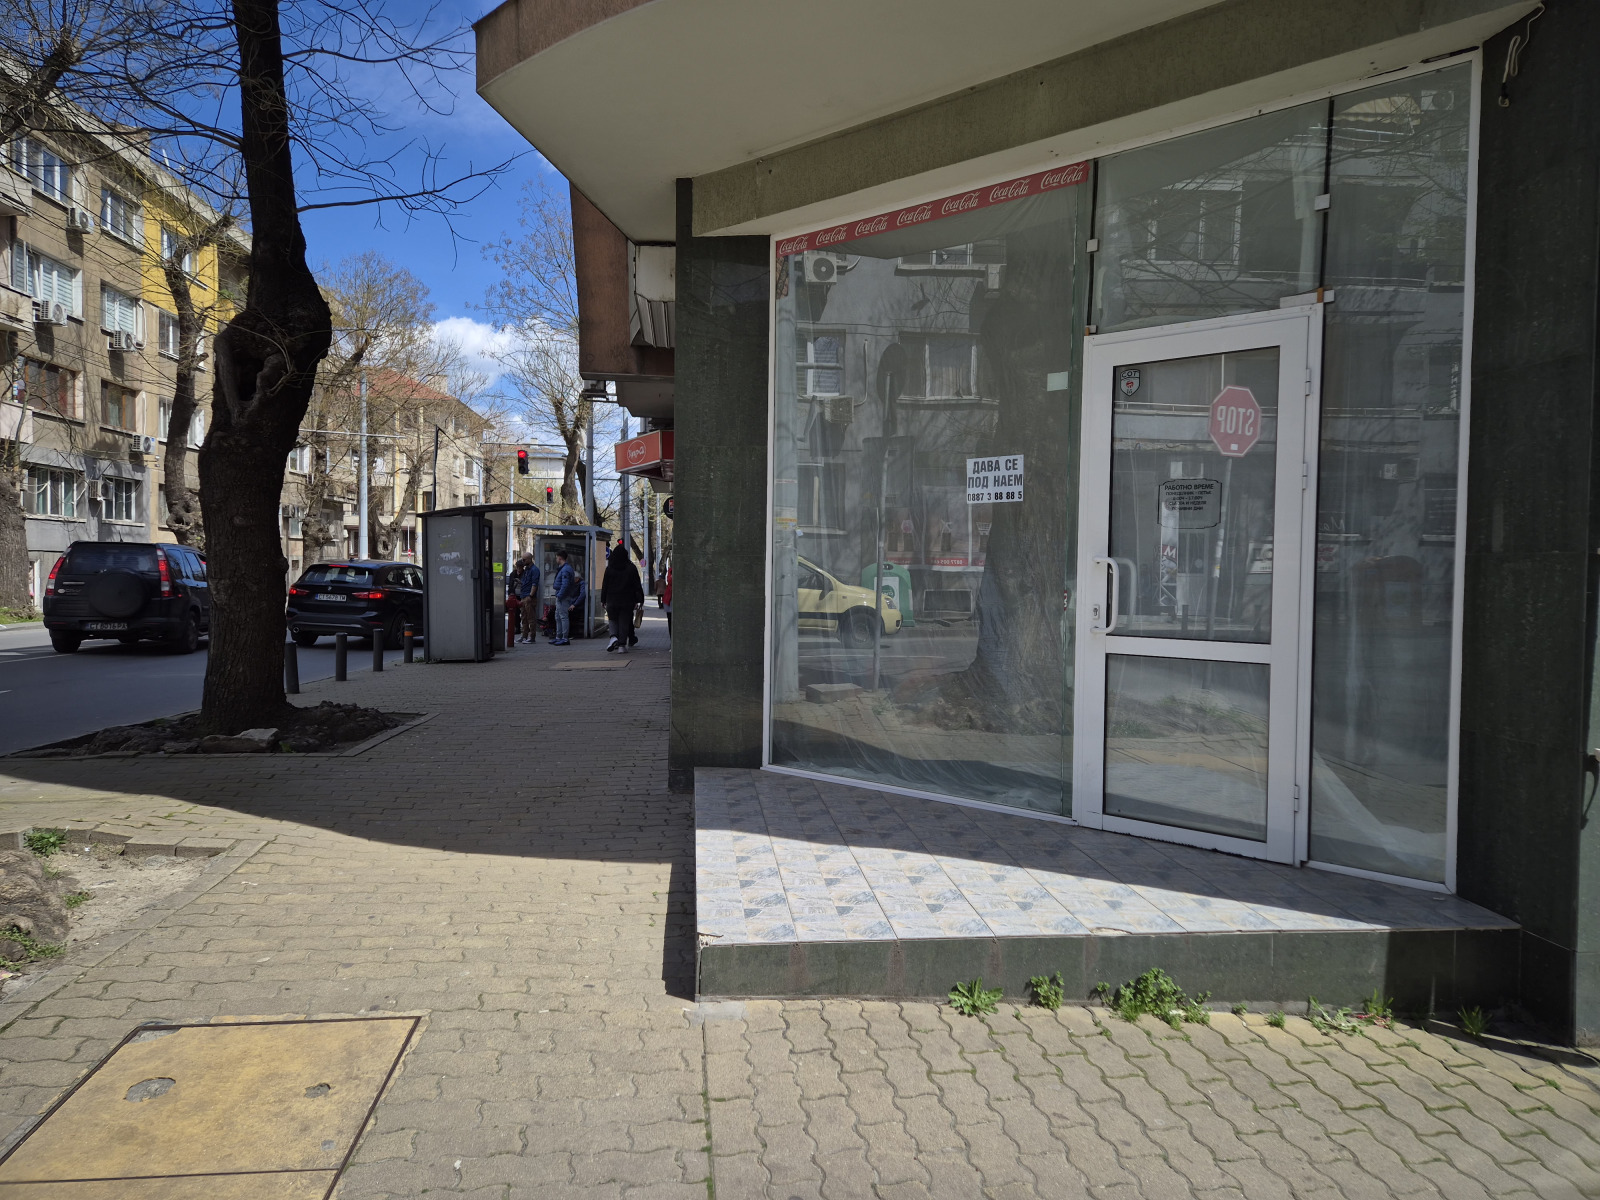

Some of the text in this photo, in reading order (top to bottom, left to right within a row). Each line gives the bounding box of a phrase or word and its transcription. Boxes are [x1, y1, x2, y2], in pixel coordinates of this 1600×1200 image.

[973, 459, 1018, 474] ДАВА СЕ
[968, 474, 1023, 489] ПОД НАЕМ
[967, 493, 984, 501] 0887
[995, 492, 1003, 500] 88
[1006, 491, 1015, 500] 88
[1018, 491, 1022, 499] 5
